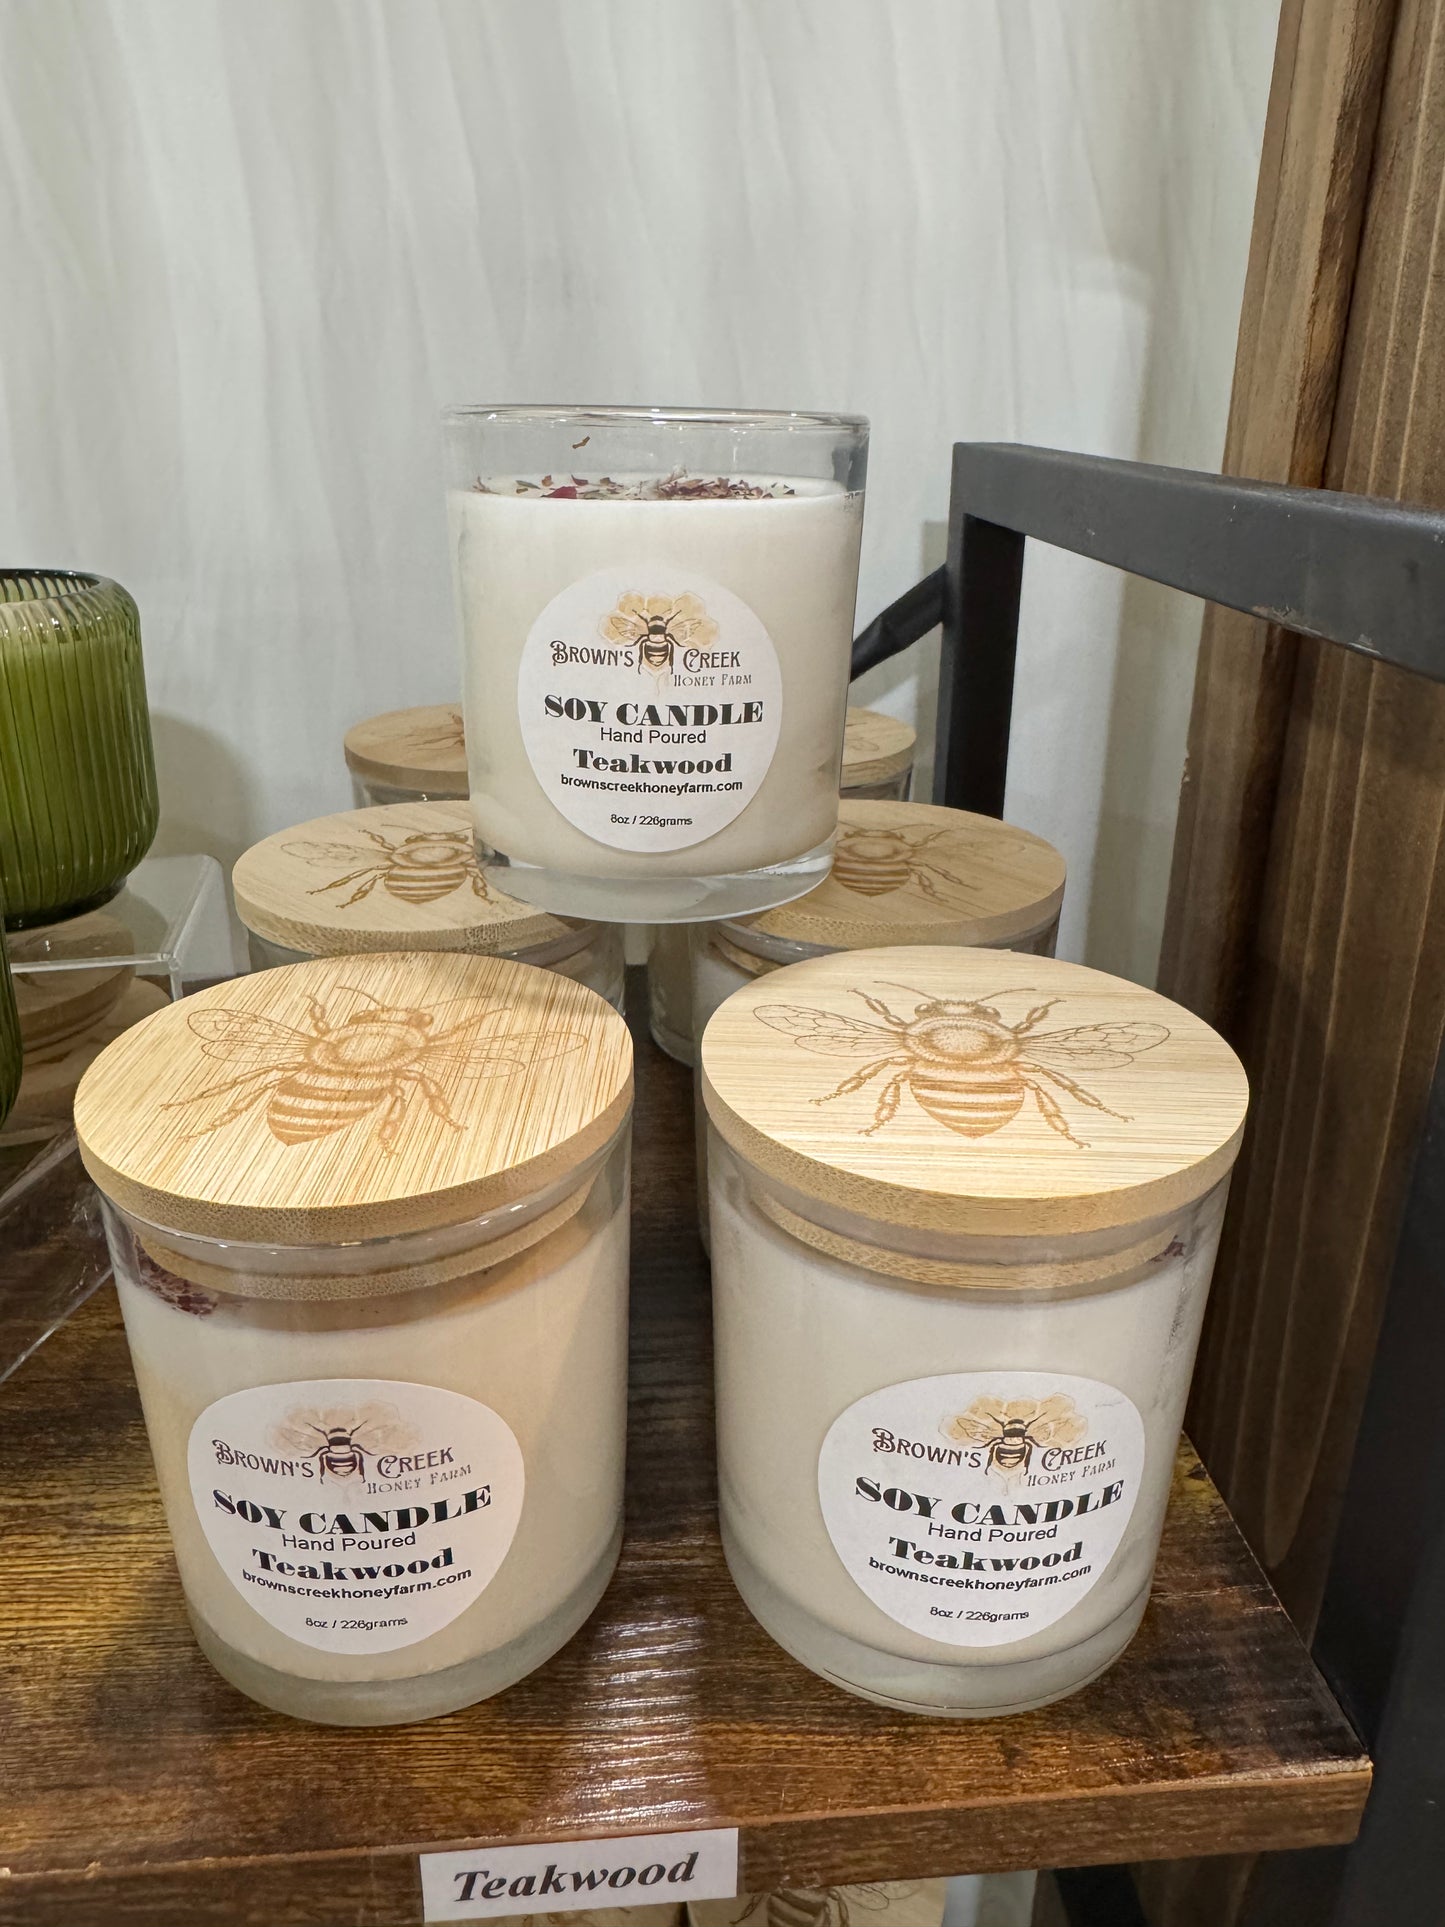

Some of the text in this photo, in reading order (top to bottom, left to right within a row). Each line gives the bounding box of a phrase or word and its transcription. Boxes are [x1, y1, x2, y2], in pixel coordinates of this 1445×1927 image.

[550, 640, 741, 672] BROWN'S CREEK
[674, 674, 751, 687] HONEY FARM
[545, 694, 763, 726] SOY CANDLE
[601, 727, 706, 744] Hand Poured
[573, 749, 732, 774] Teakwood
[561, 774, 742, 795] brownscreekhoneyfarm.com
[611, 814, 630, 824] 8oz
[639, 815, 692, 827] 226grams
[212, 1439, 454, 1478] BROWN'S CREEK
[872, 1428, 1107, 1472] BROWN'S CREEK
[367, 1464, 471, 1494] HONEY FARM
[1027, 1459, 1116, 1487] HONEY FARM
[213, 1484, 491, 1535] SOY CANDLE
[856, 1476, 1124, 1525] SOY CANDLE
[282, 1532, 416, 1551] Hand Poured
[928, 1522, 1057, 1542] Hand Poured
[252, 1547, 454, 1580] Teakwood
[889, 1537, 1083, 1571] Teakwood
[242, 1569, 472, 1599] brownscreekhoneyfarm.com
[869, 1557, 1091, 1591] brownscreekhoneyfarm.com
[305, 1617, 328, 1628] 8oz
[340, 1617, 408, 1630] 226grams
[930, 1607, 953, 1618] 8oz
[965, 1610, 1029, 1622] 226grams
[453, 1852, 700, 1902] Teakwood
